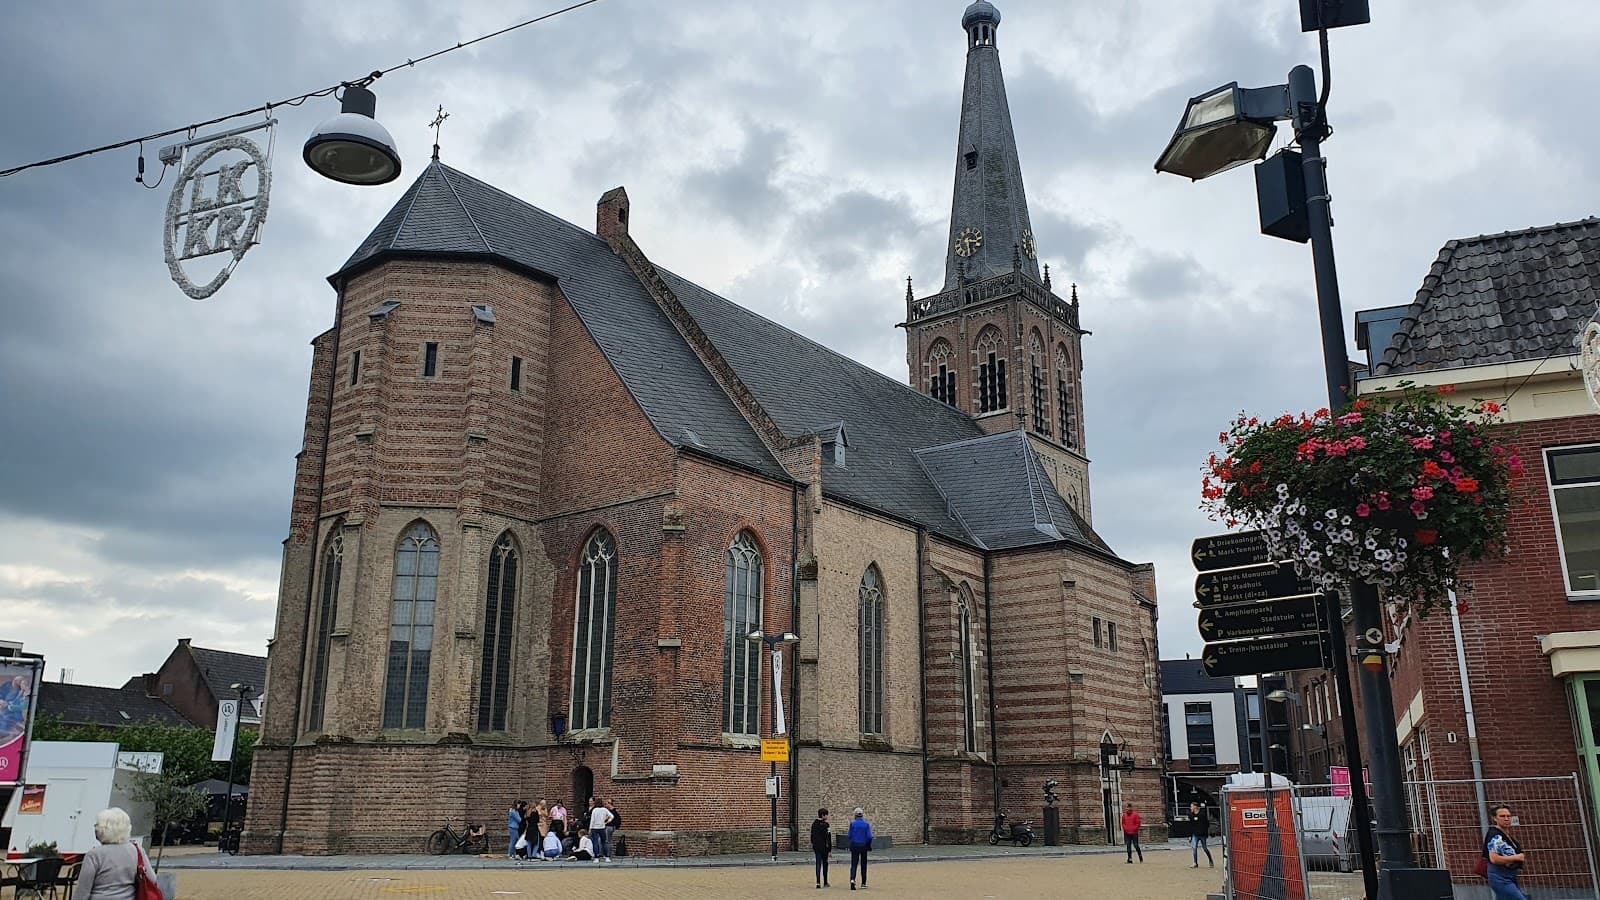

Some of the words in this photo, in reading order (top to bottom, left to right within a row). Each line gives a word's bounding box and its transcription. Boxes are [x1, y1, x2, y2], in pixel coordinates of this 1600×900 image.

[1241, 569, 1279, 579] Monument
[1222, 583, 1229, 592] P
[1231, 581, 1262, 590] Stadhuis
[1222, 593, 1243, 601] Markt
[1260, 614, 1295, 623] Stadstuin
[1217, 629, 1224, 638] P
[1226, 626, 1275, 637] Varkensweide
